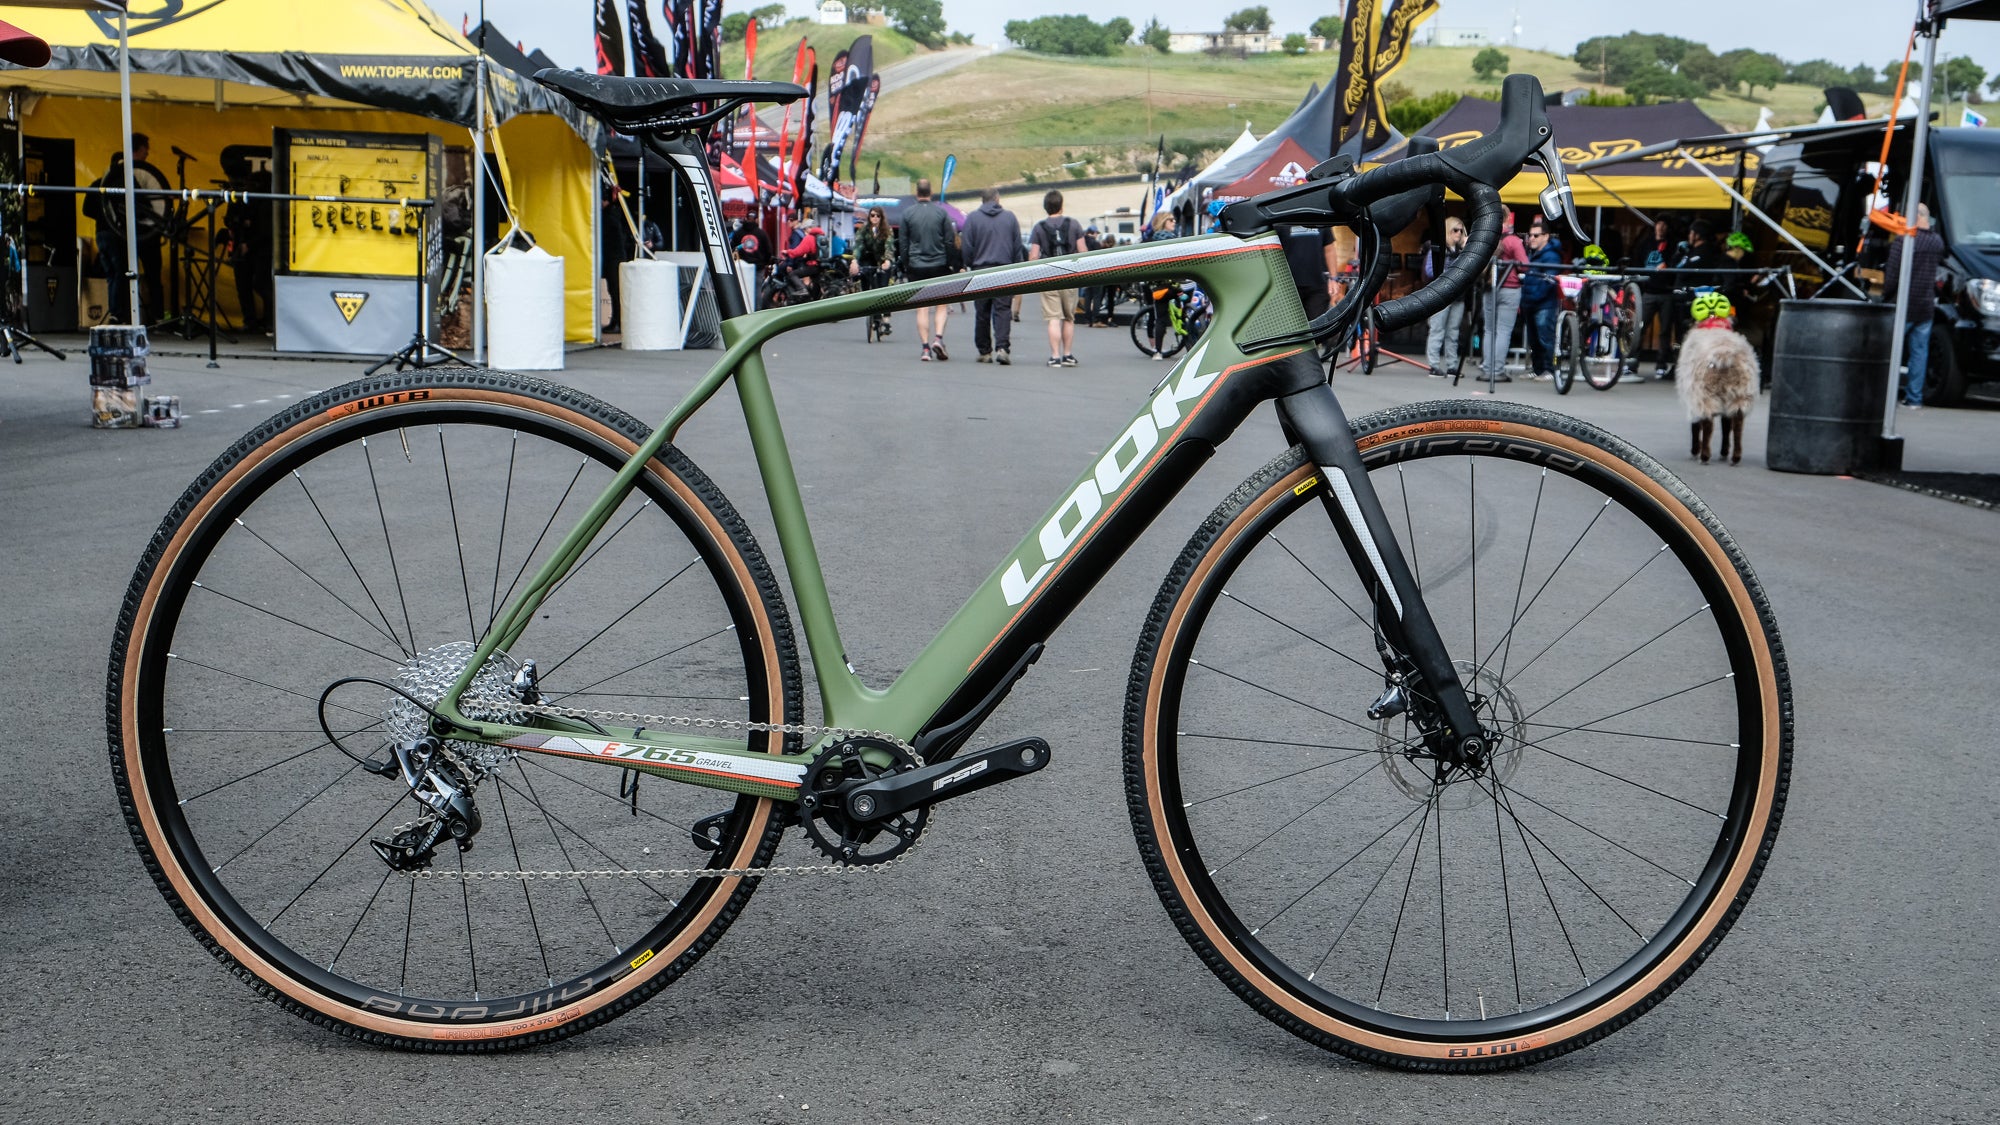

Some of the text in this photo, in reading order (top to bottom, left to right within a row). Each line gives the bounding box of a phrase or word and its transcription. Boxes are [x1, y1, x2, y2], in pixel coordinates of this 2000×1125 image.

[1347, 40, 1364, 78] Lee
[340, 65, 463, 80] WWW.TOPEAK.COM
[1344, 76, 1368, 115] Troy
[291, 137, 315, 146] NINJA
[316, 138, 347, 147] MASTER
[700, 189, 718, 241] LOOK
[358, 391, 429, 410] WTB
[1407, 427, 1425, 435] 700
[1425, 420, 1489, 432] RIDDLER
[1382, 431, 1399, 441] 37C
[1000, 338, 1221, 607] LOOK
[1296, 478, 1315, 494] MAVIC
[696, 758, 733, 770] GRAVEL
[633, 950, 651, 967] MAVIC
[511, 1023, 528, 1031] 700
[537, 1016, 554, 1026] 37C
[446, 1026, 511, 1039] RIDDLER
[1448, 1042, 1518, 1058] WTB
